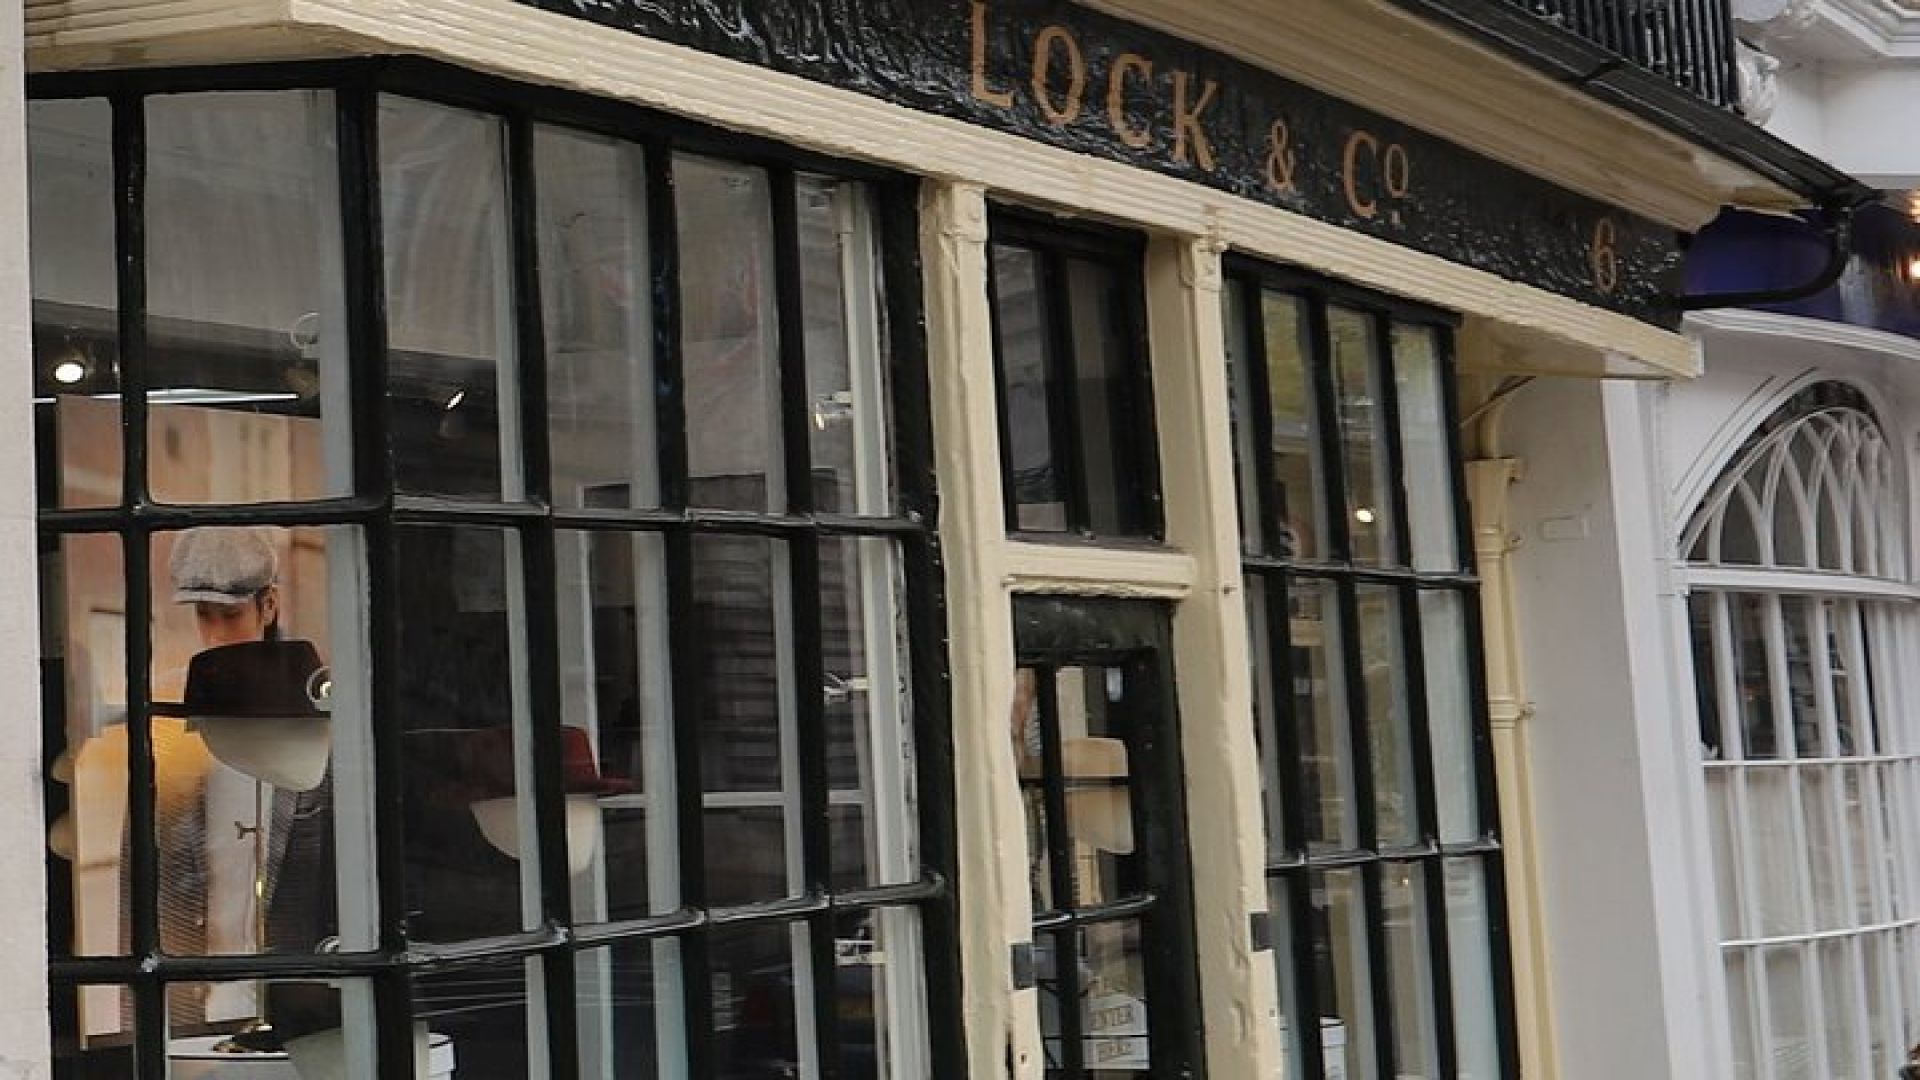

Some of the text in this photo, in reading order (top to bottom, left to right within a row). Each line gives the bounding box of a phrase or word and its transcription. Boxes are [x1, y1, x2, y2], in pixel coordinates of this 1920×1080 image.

[970, 0, 1217, 171] LOCK
[1266, 119, 1294, 191] &
[1592, 218, 1617, 291] 6
